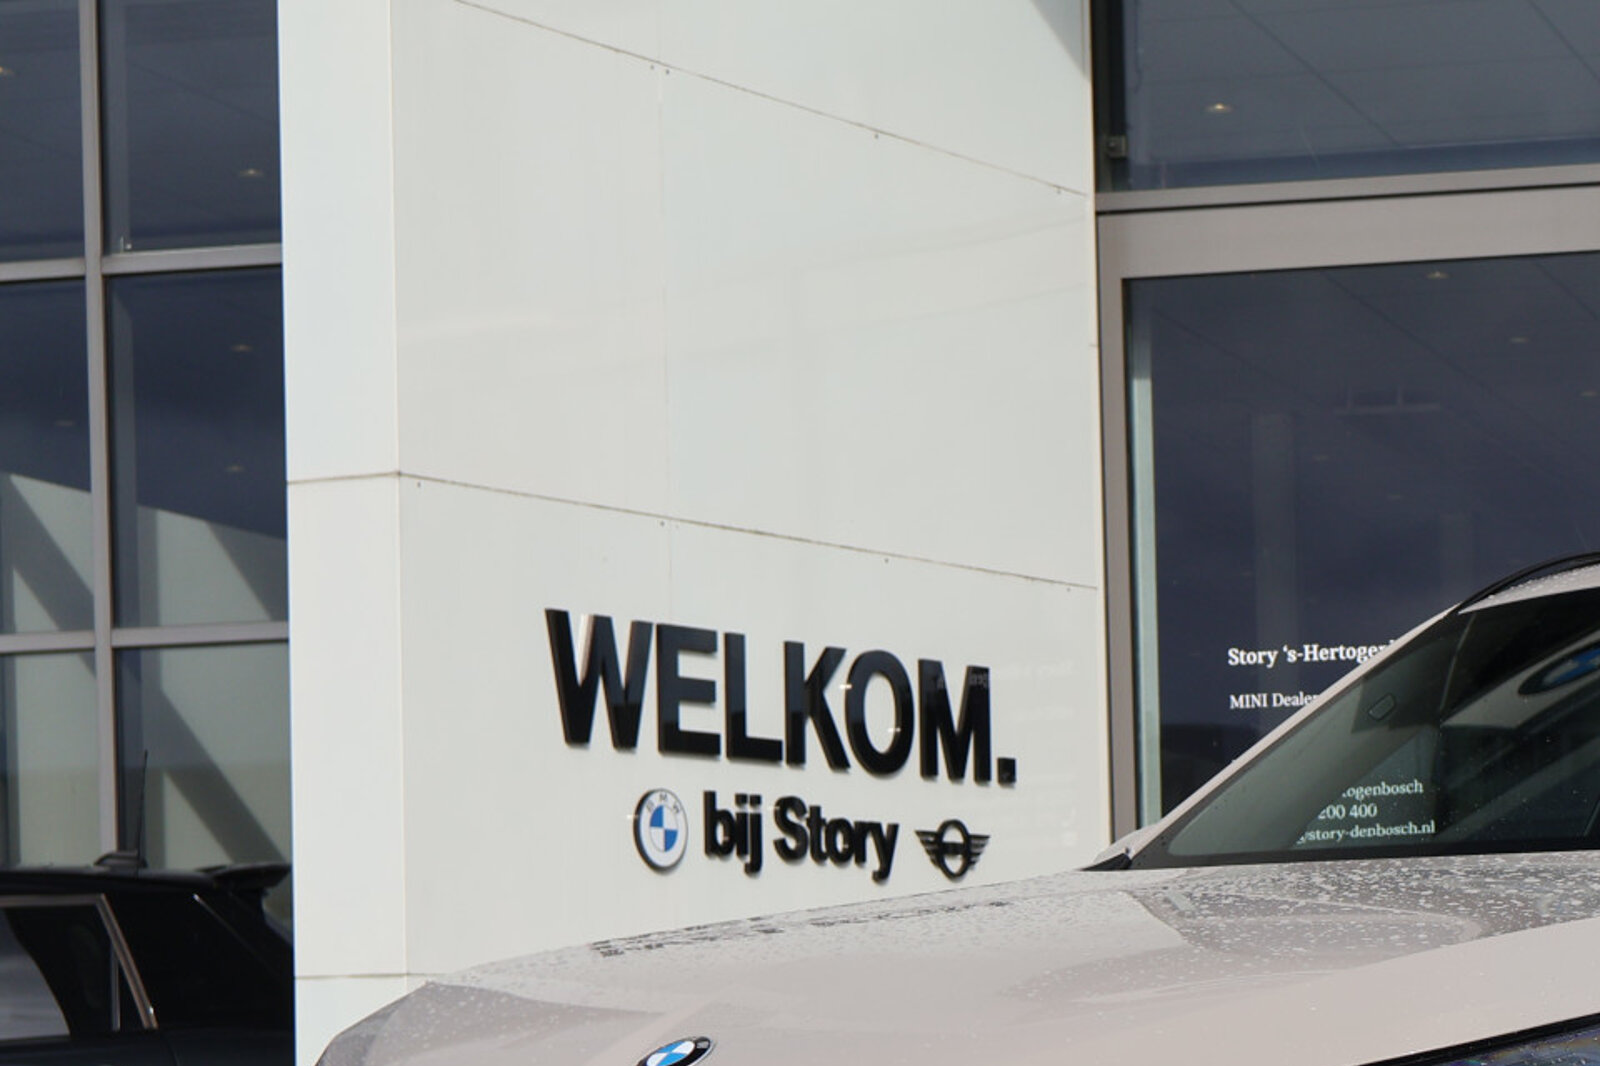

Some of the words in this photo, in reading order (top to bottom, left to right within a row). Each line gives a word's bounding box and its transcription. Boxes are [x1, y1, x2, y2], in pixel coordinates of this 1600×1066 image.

[1227, 647, 1279, 669] Story
[1282, 640, 1397, 664] ‘s-Hertoge
[545, 608, 1017, 785] WELKOM.
[1229, 693, 1268, 710] MINI
[1342, 778, 1424, 801] ogenbosch
[1349, 802, 1378, 819] 400
[702, 790, 763, 875] bij
[772, 795, 901, 882] Story
